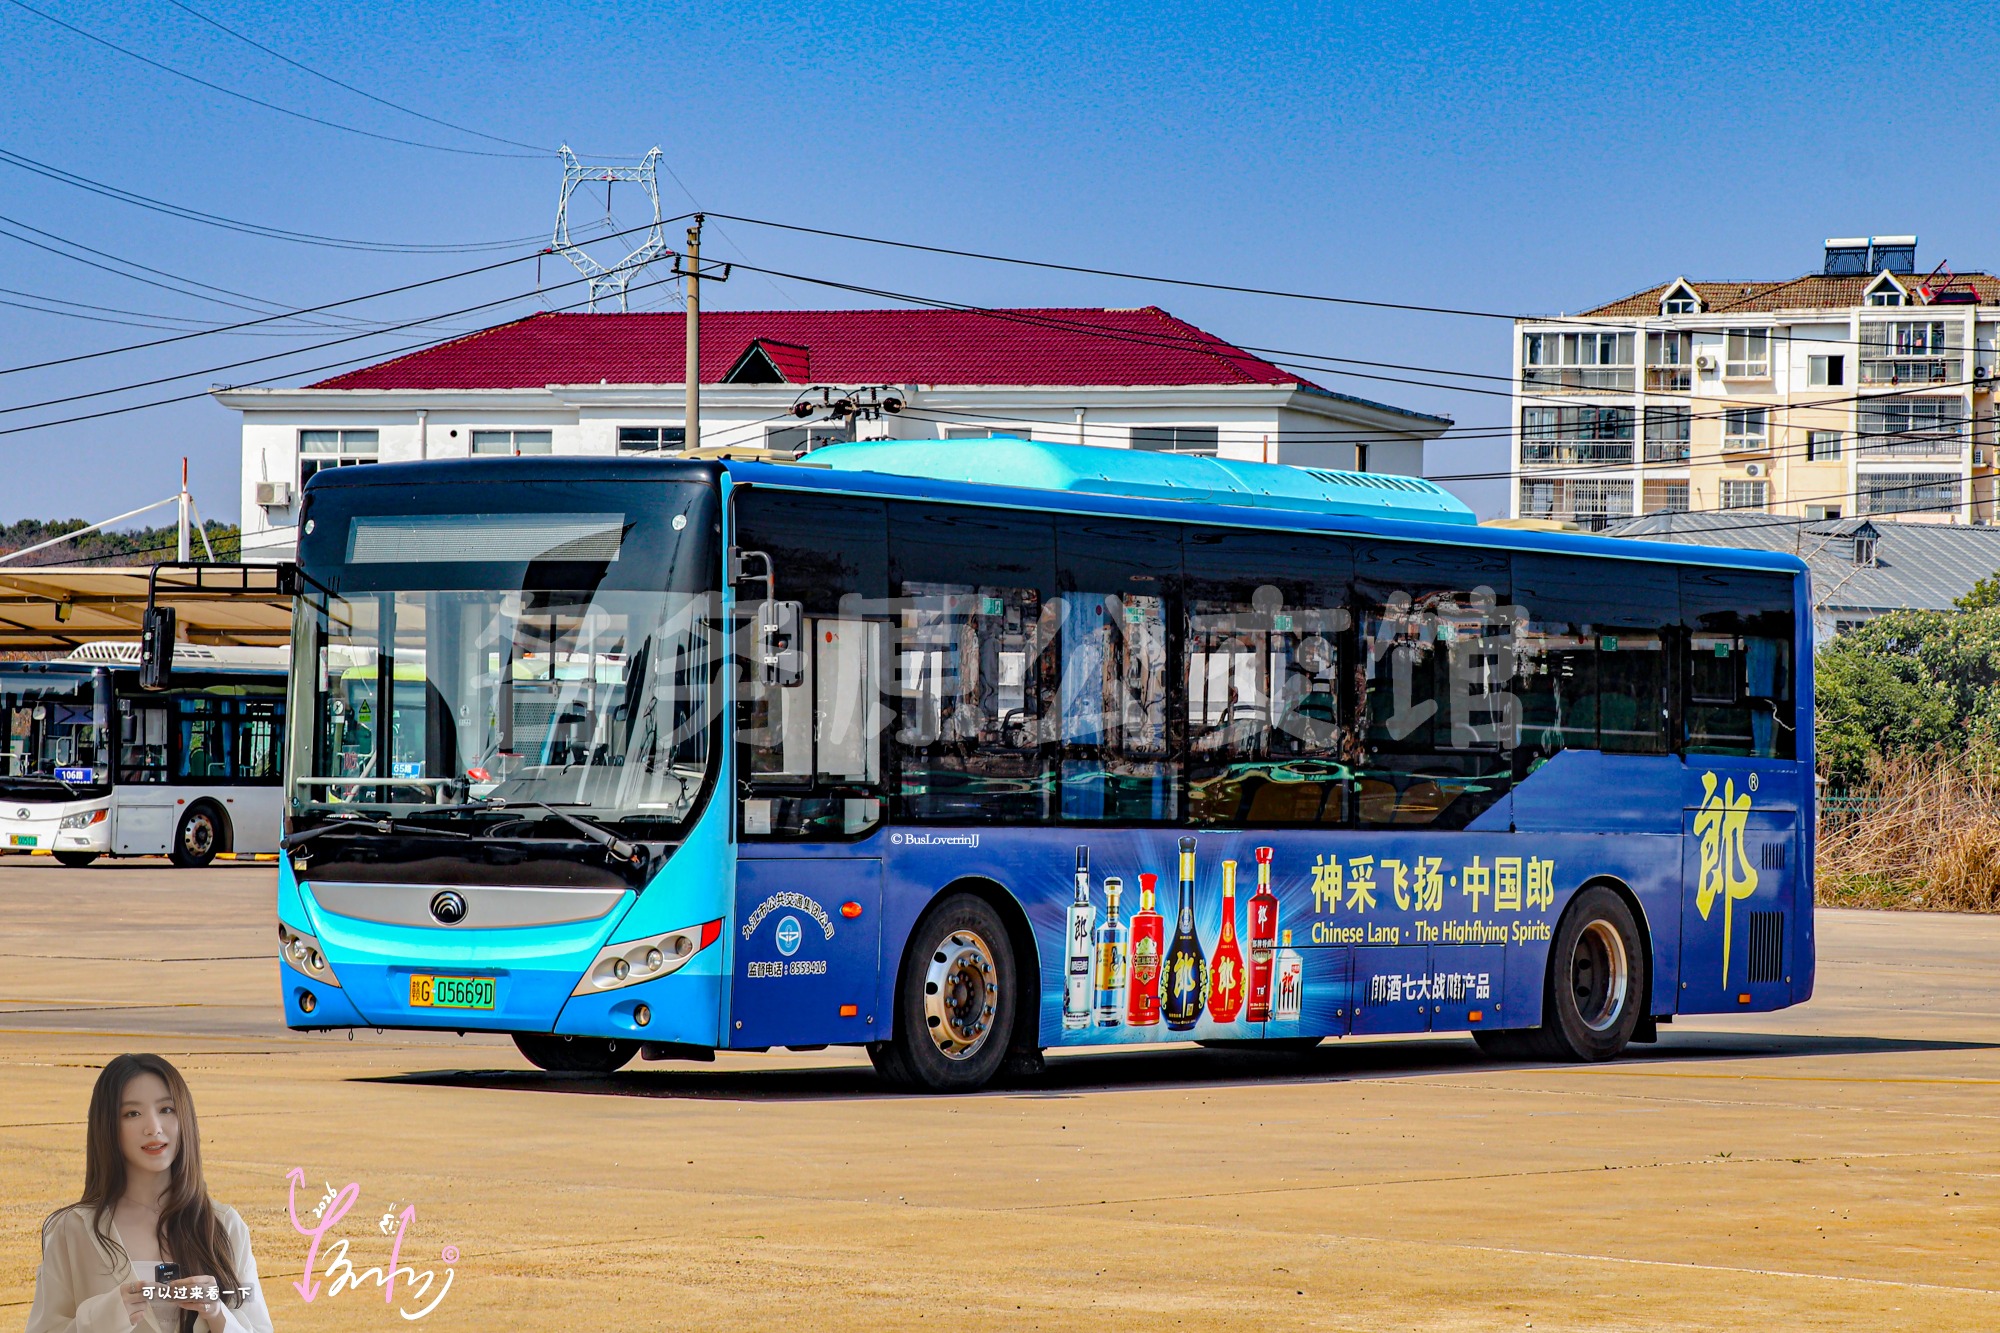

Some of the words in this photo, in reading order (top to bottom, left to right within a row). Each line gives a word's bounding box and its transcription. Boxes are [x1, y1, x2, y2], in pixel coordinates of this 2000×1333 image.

[1311, 854, 1555, 914] 神采飞扬·中国郎
[1693, 770, 1759, 992] 郎
[742, 890, 835, 941] 九江市公共交通集团公司
[1311, 921, 1364, 944] Chinese
[1367, 922, 1400, 947] Lang
[1415, 920, 1439, 942] The
[1442, 920, 1509, 947] Highflying
[1511, 918, 1551, 946] Spirits
